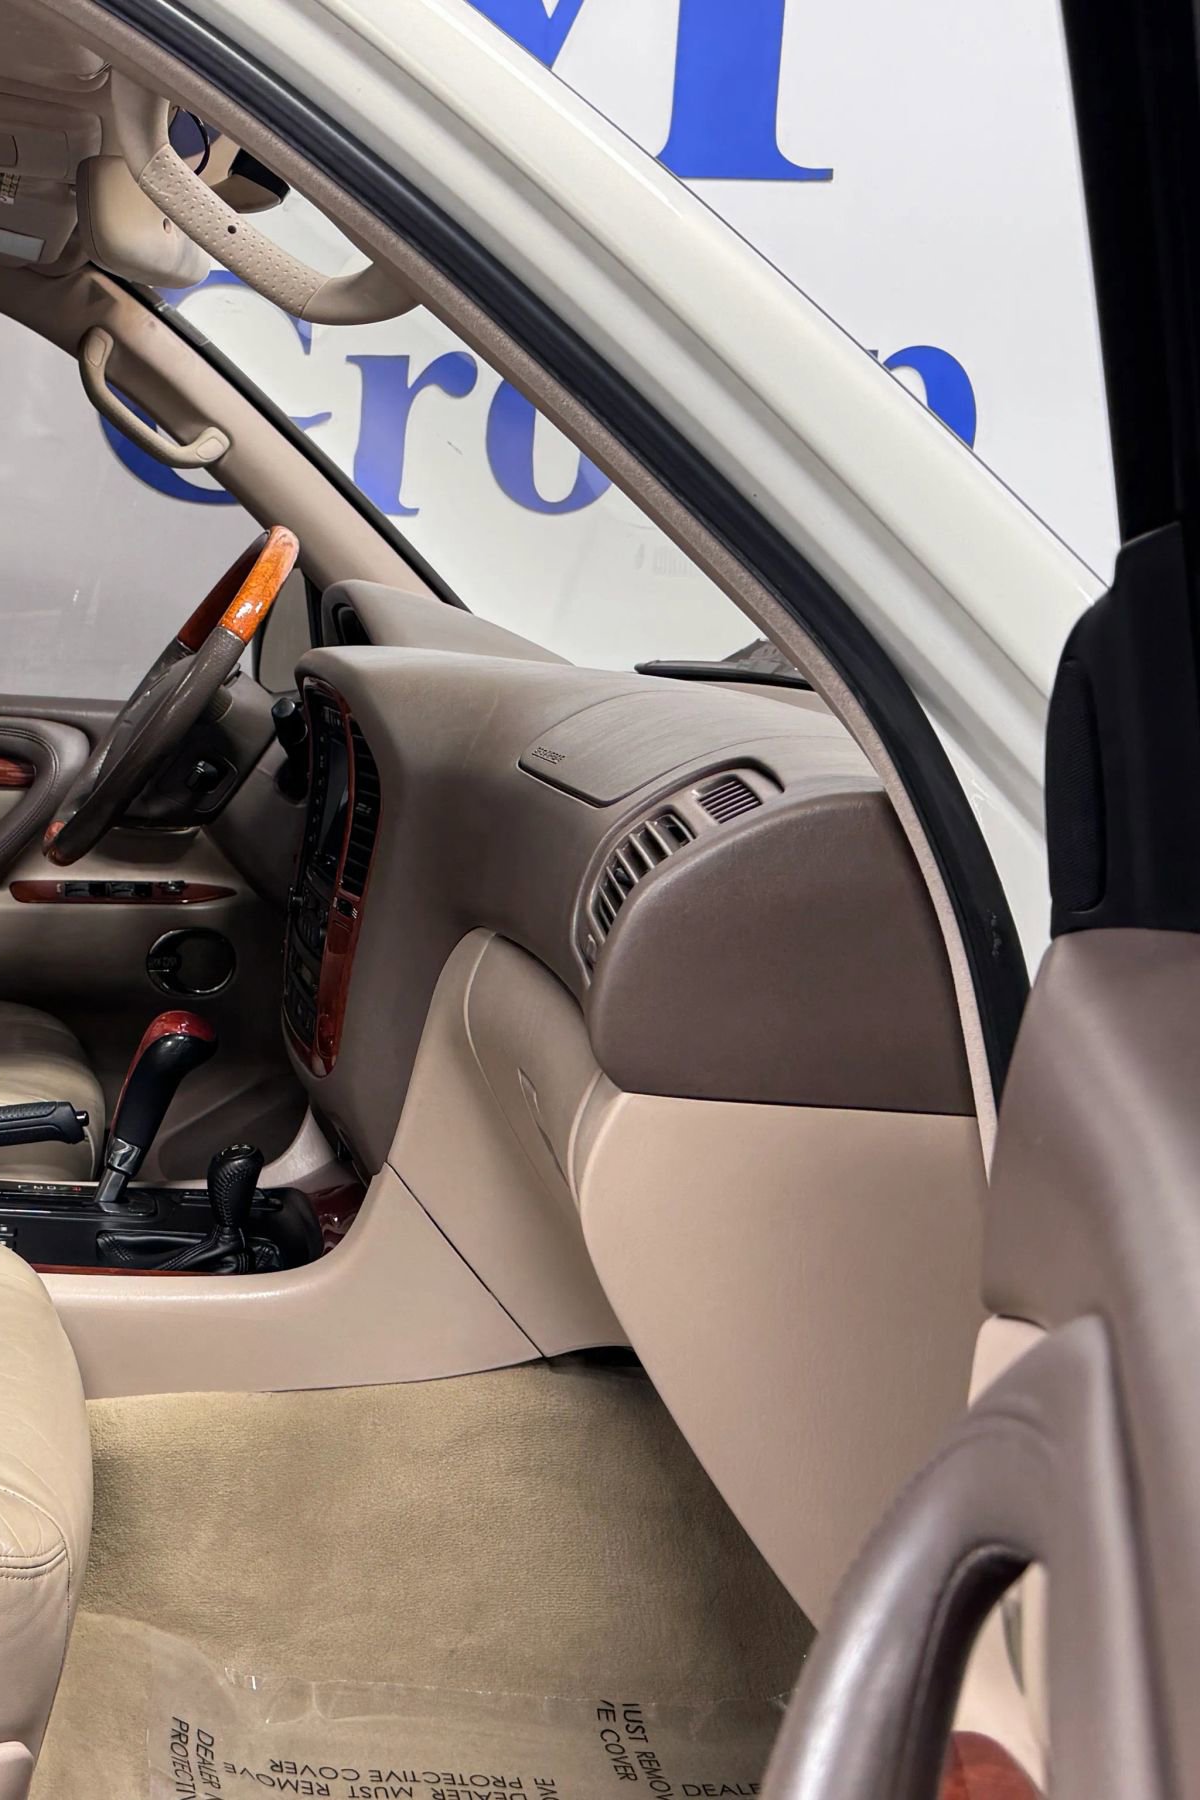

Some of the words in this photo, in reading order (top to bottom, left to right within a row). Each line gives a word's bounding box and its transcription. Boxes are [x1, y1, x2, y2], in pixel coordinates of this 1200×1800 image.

[196, 1728, 222, 1789] DEALER
[269, 1758, 361, 1782] COVER
[600, 1728, 638, 1782] COVER
[223, 1761, 331, 1797] REMOVE
[348, 1785, 414, 1799] MUST
[369, 1769, 524, 1789] PROTECTIVE
